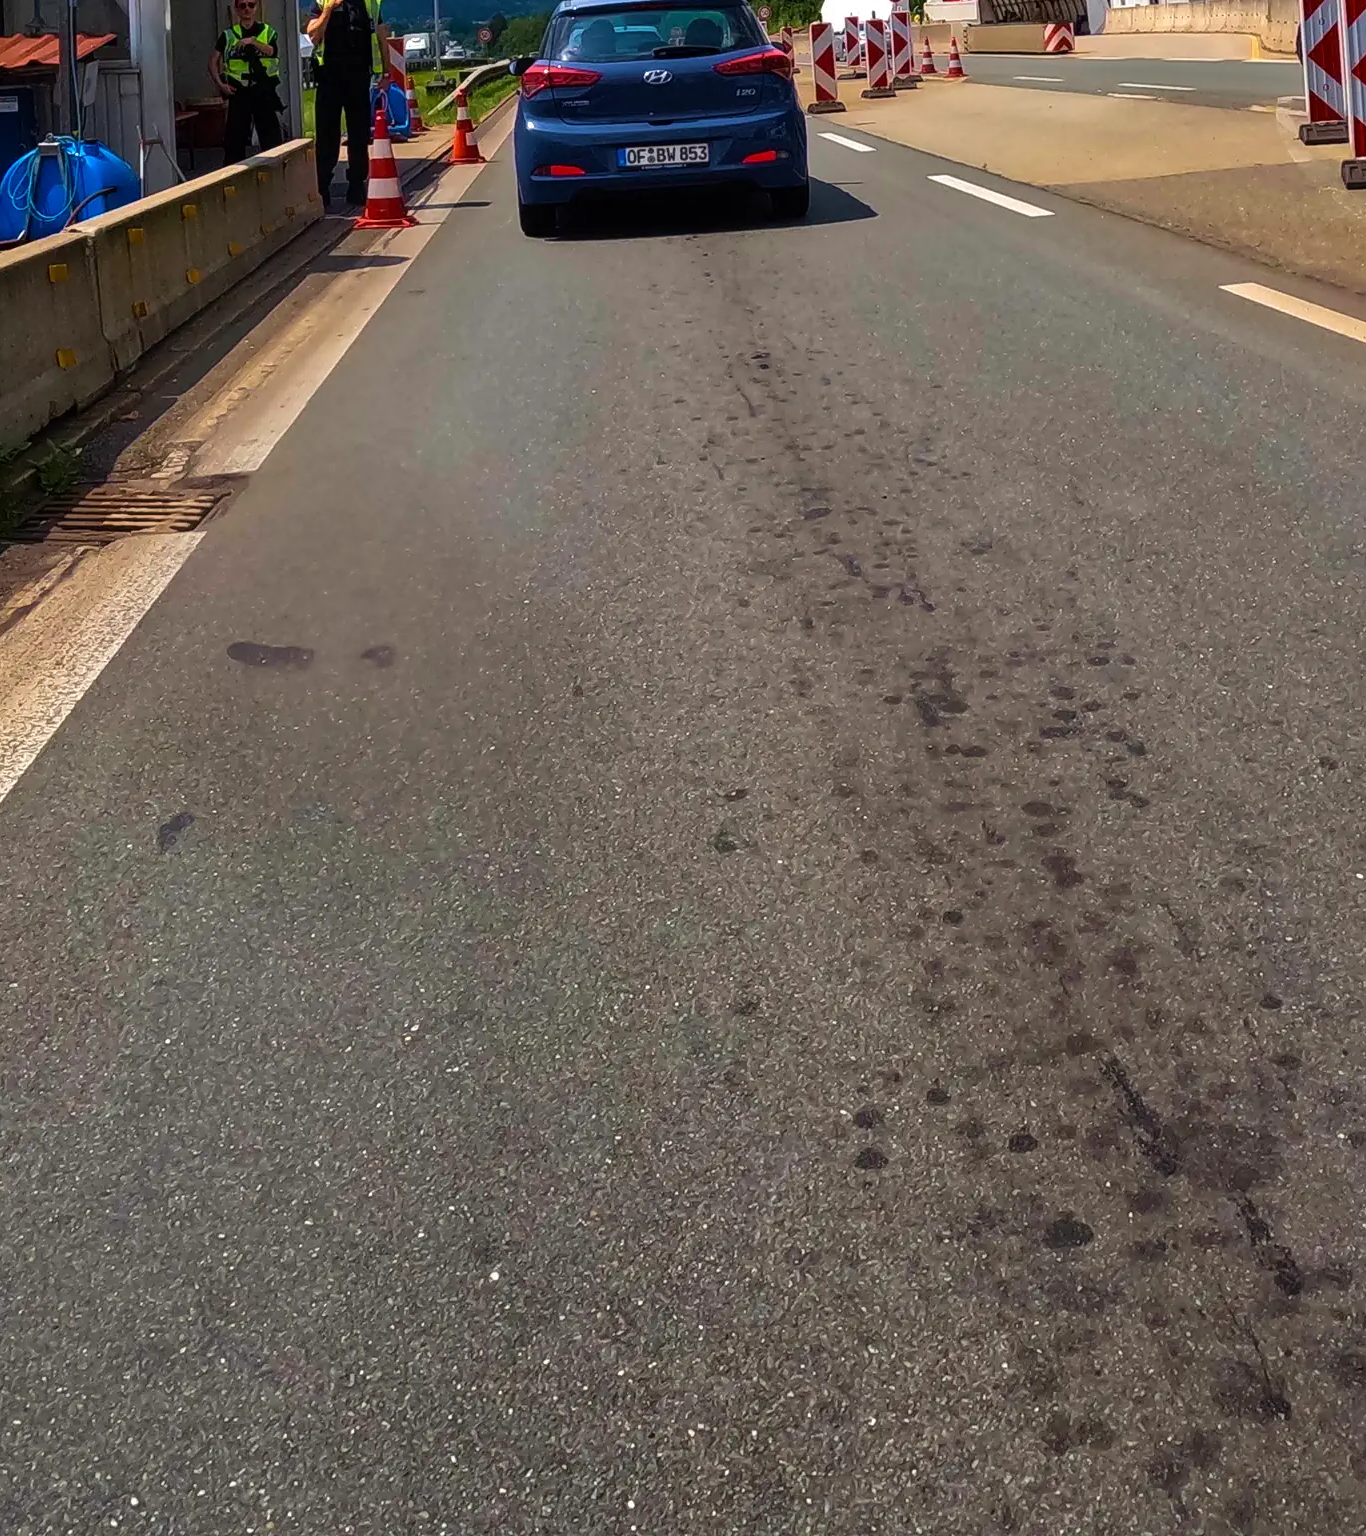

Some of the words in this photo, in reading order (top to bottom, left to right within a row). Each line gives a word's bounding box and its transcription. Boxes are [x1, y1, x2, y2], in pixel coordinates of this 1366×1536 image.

[627, 149, 646, 164] OF
[656, 147, 676, 163] BW
[679, 146, 707, 161] 853
